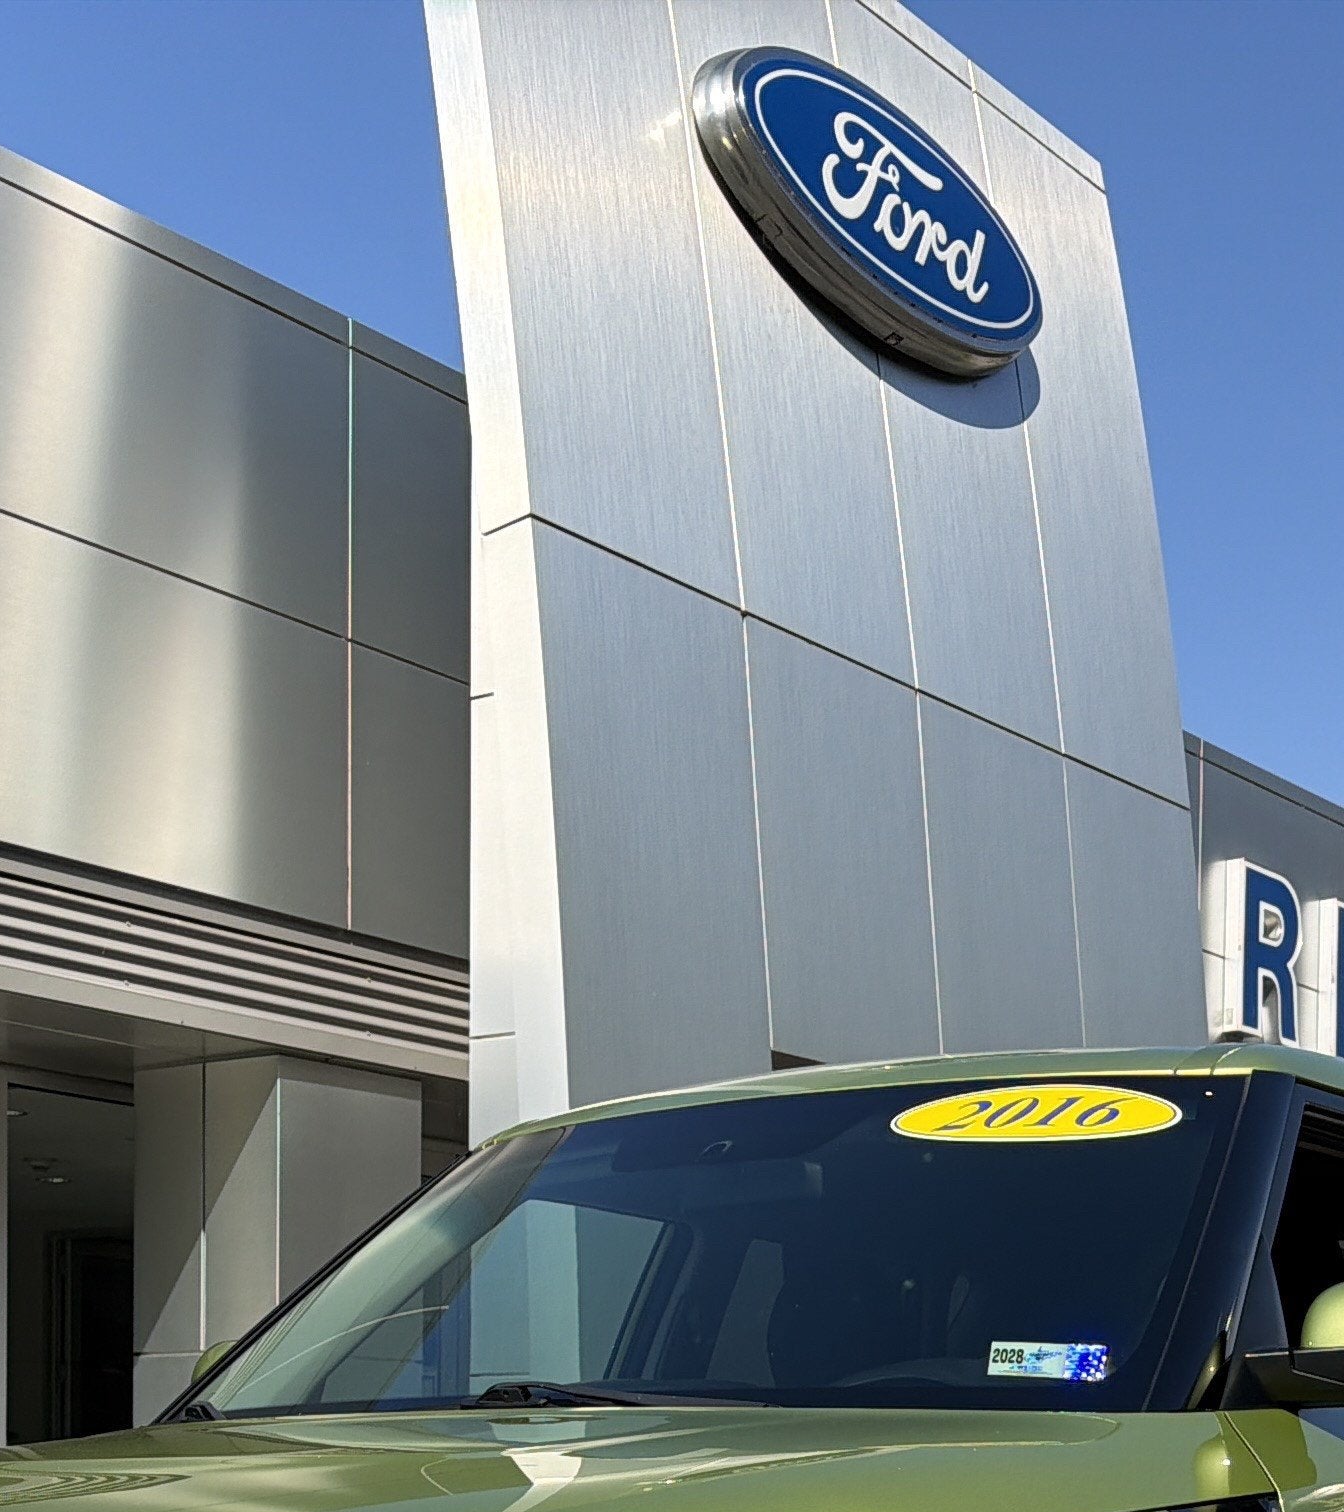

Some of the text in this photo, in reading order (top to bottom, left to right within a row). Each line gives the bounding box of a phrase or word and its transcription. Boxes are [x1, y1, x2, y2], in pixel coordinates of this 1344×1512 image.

[822, 111, 989, 303] Ford
[932, 1096, 1138, 1132] 2016
[992, 1348, 1025, 1364] 2028
